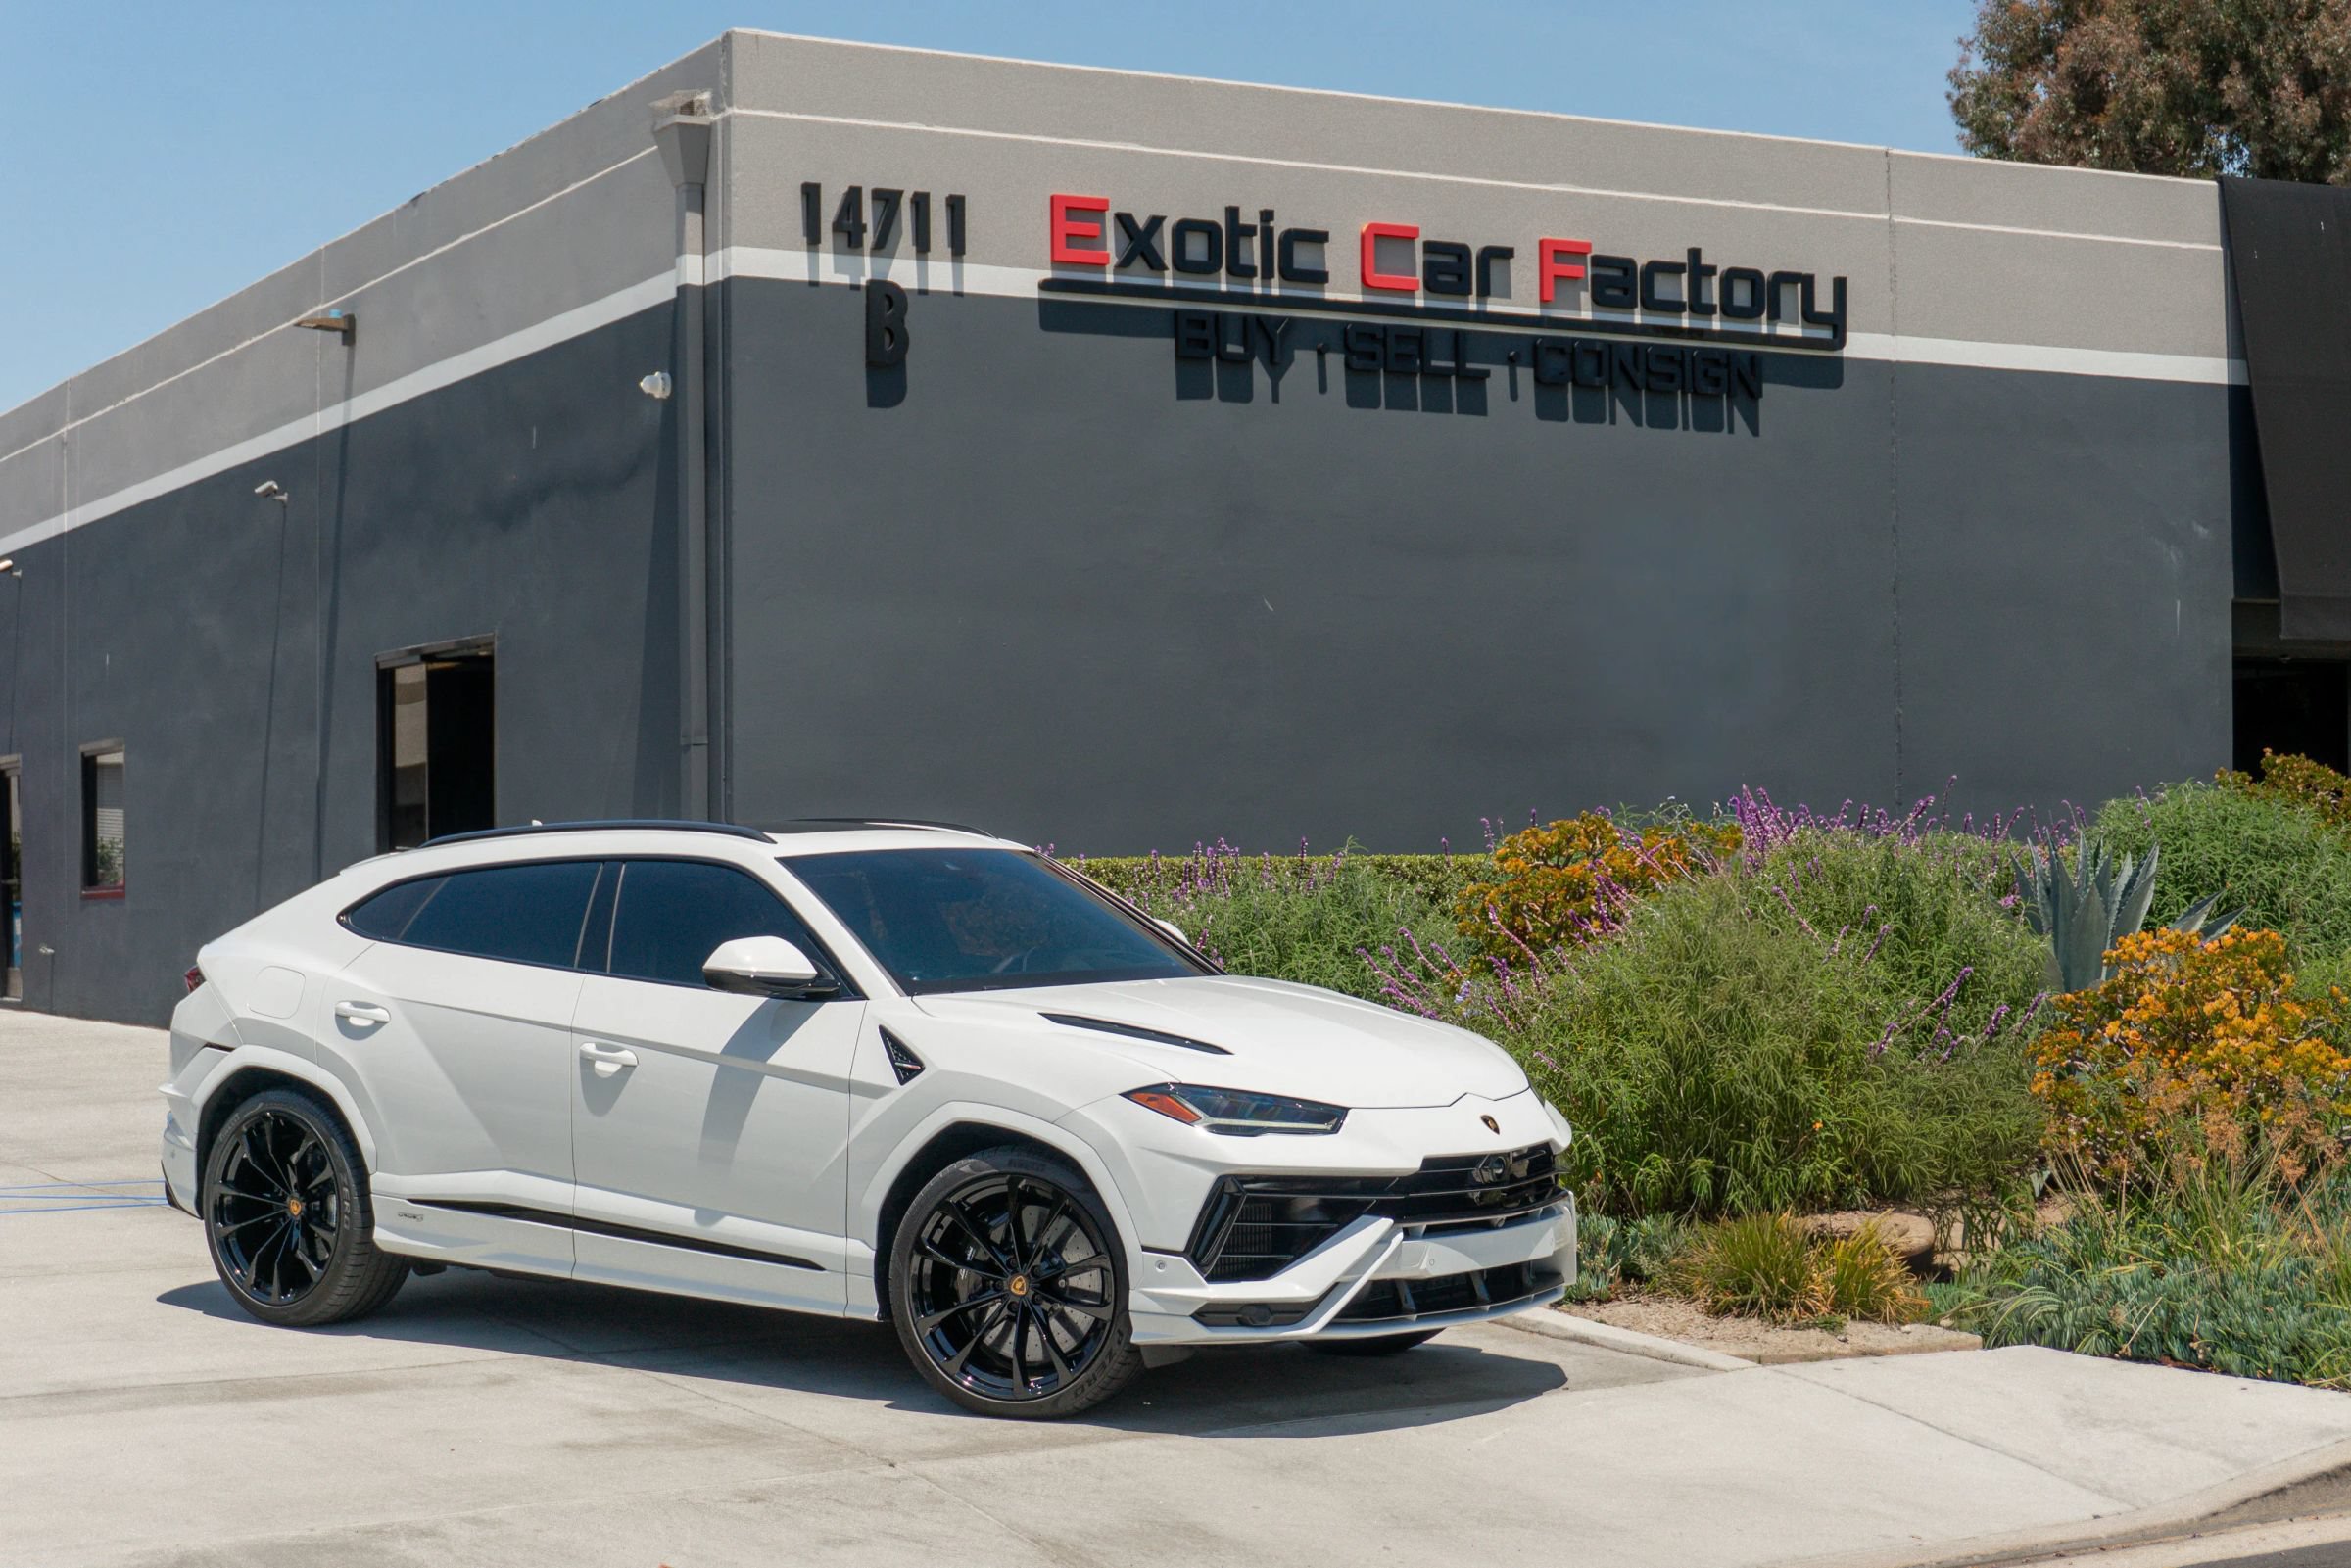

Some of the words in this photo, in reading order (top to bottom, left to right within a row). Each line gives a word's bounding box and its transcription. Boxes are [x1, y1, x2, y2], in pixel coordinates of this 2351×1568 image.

[801, 181, 966, 257] 14711
[1050, 194, 1329, 285] Exotic
[1361, 222, 1515, 297] Car
[1539, 237, 1847, 351] Factory
[865, 278, 910, 369] B
[1175, 309, 1291, 365] BUY
[1344, 323, 1491, 379] SELL
[1533, 337, 1763, 400] CONSIGN
